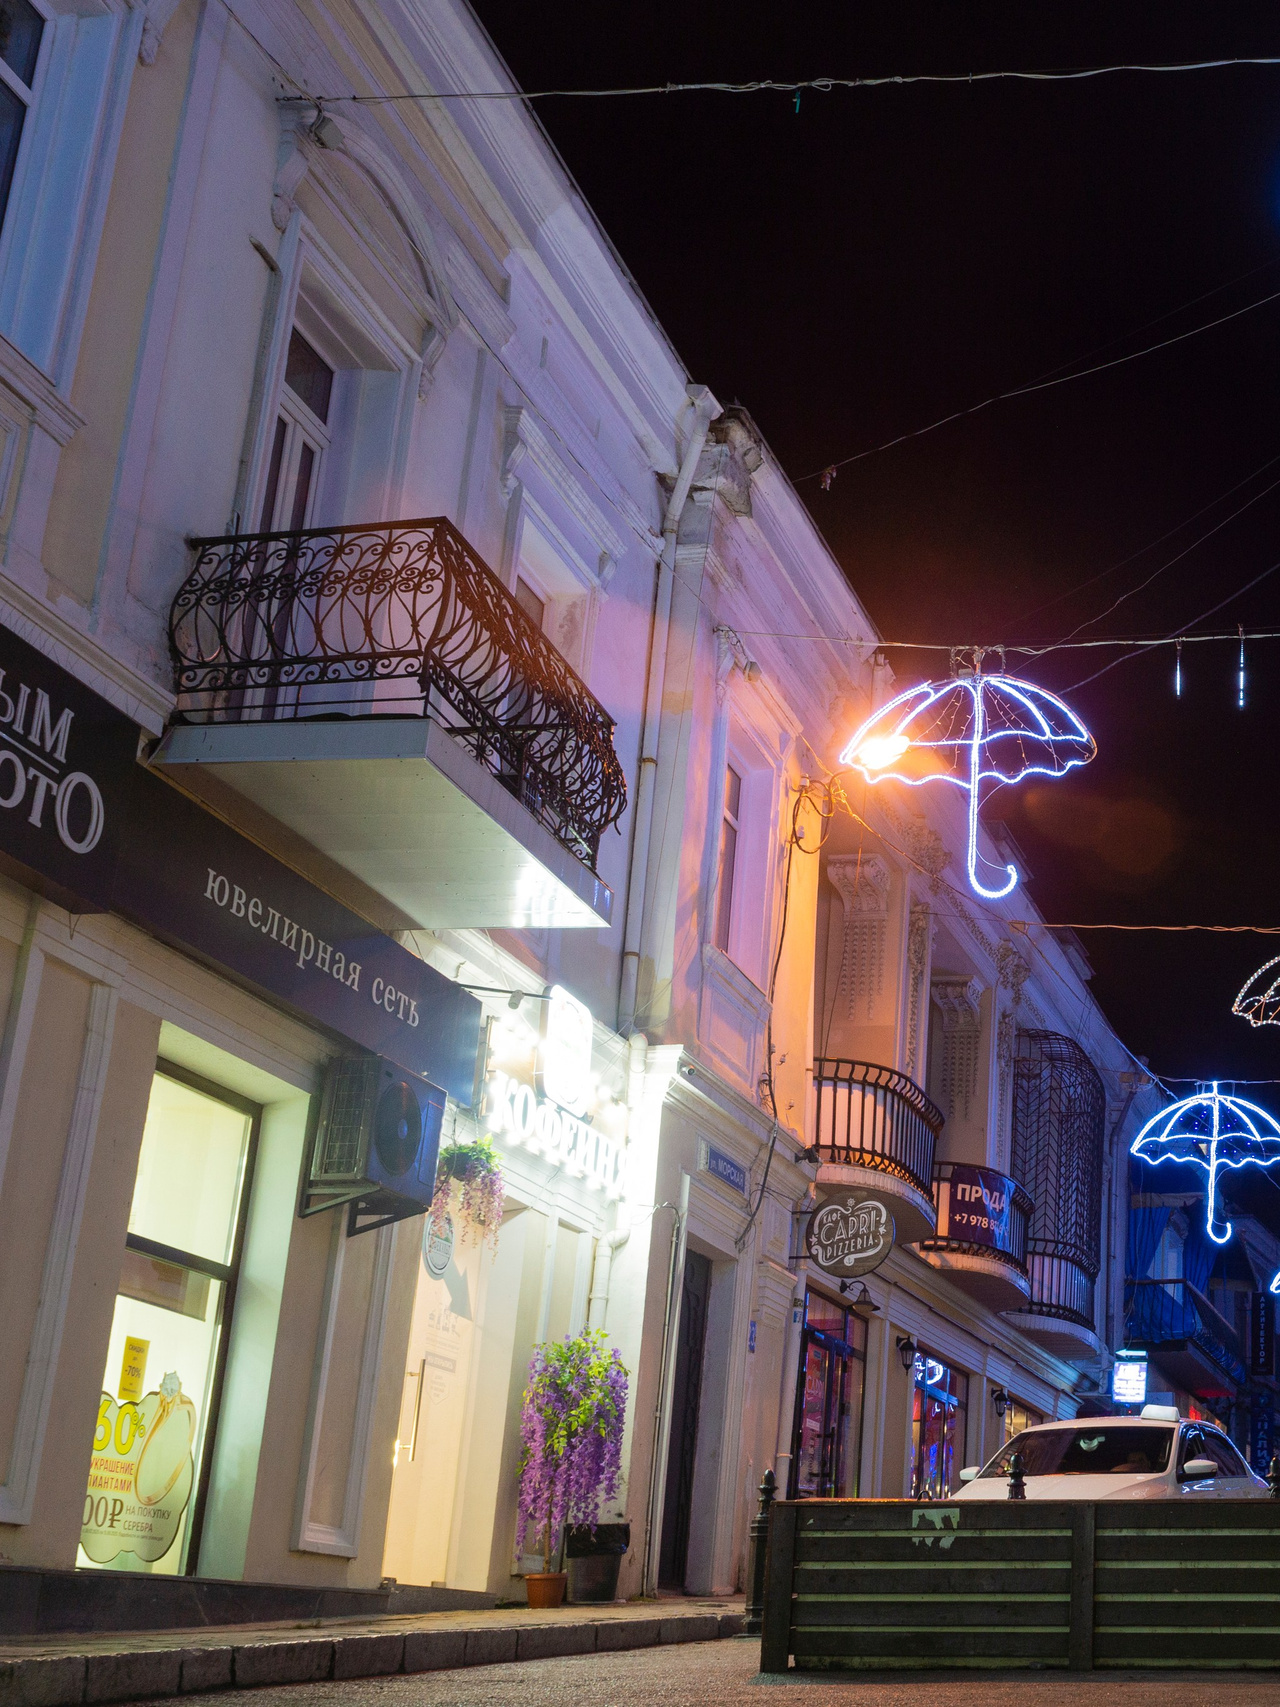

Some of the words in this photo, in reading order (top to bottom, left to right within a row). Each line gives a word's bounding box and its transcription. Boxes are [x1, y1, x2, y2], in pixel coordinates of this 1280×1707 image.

[371, 977, 420, 1028] сеть
[718, 1158, 744, 1188] МОРСКАЯ
[823, 1211, 841, 1224] КАФЕ
[954, 1213, 968, 1225] +7
[969, 1215, 989, 1229] 978
[820, 1209, 876, 1245] CAPRI
[826, 1233, 874, 1259] PIZZERIA
[125, 1365, 141, 1378] -70%
[126, 1505, 136, 1515] НА
[137, 1507, 172, 1520] ПОКУПКУ
[123, 1520, 154, 1533] СЕРЕБРА
